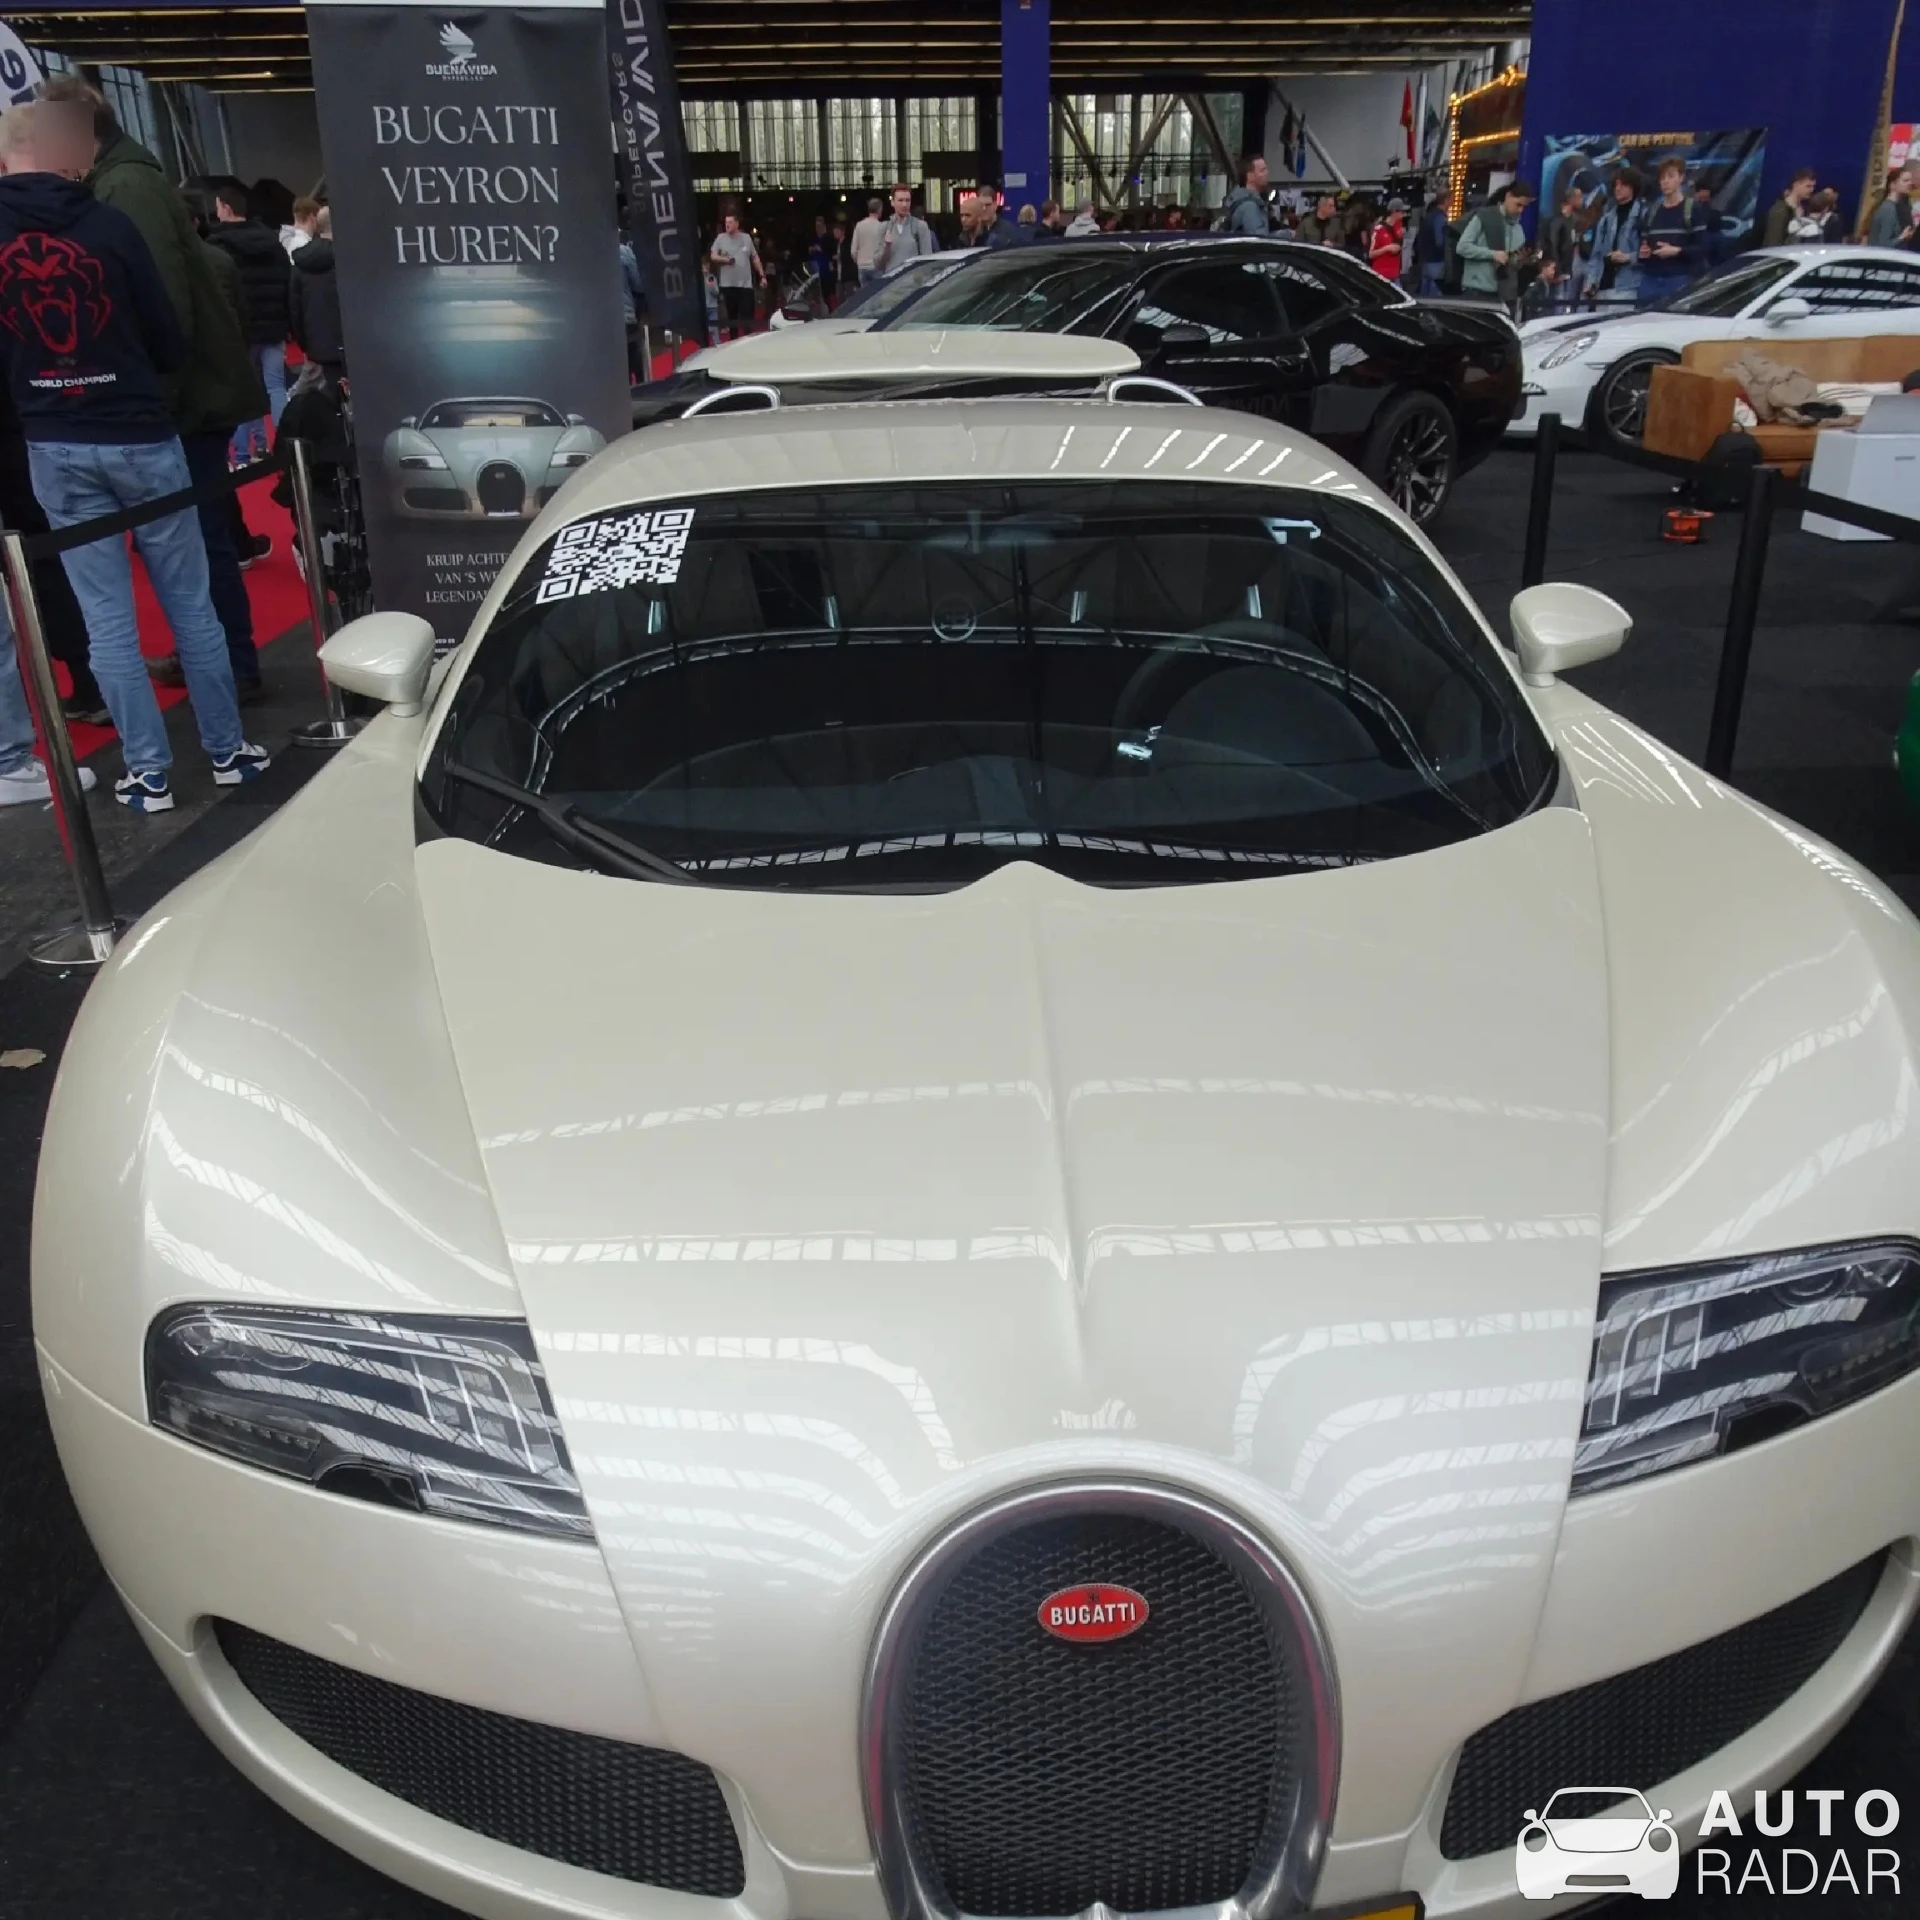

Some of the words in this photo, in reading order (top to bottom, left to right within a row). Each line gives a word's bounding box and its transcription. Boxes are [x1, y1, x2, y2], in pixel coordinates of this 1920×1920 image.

[425, 64, 497, 75] BUENAVIDA
[372, 105, 559, 145] BUGATTI
[381, 165, 559, 204] VEYRON
[395, 225, 560, 263] HUREN?
[29, 379, 63, 388] WORLD
[64, 373, 117, 387] CHAMPION
[427, 554, 463, 566] KRUIP
[467, 552, 511, 565] ACHTE
[435, 572, 462, 584] VAN
[426, 589, 488, 603] LEGENDA
[1051, 1602, 1136, 1626] BUGATTI
